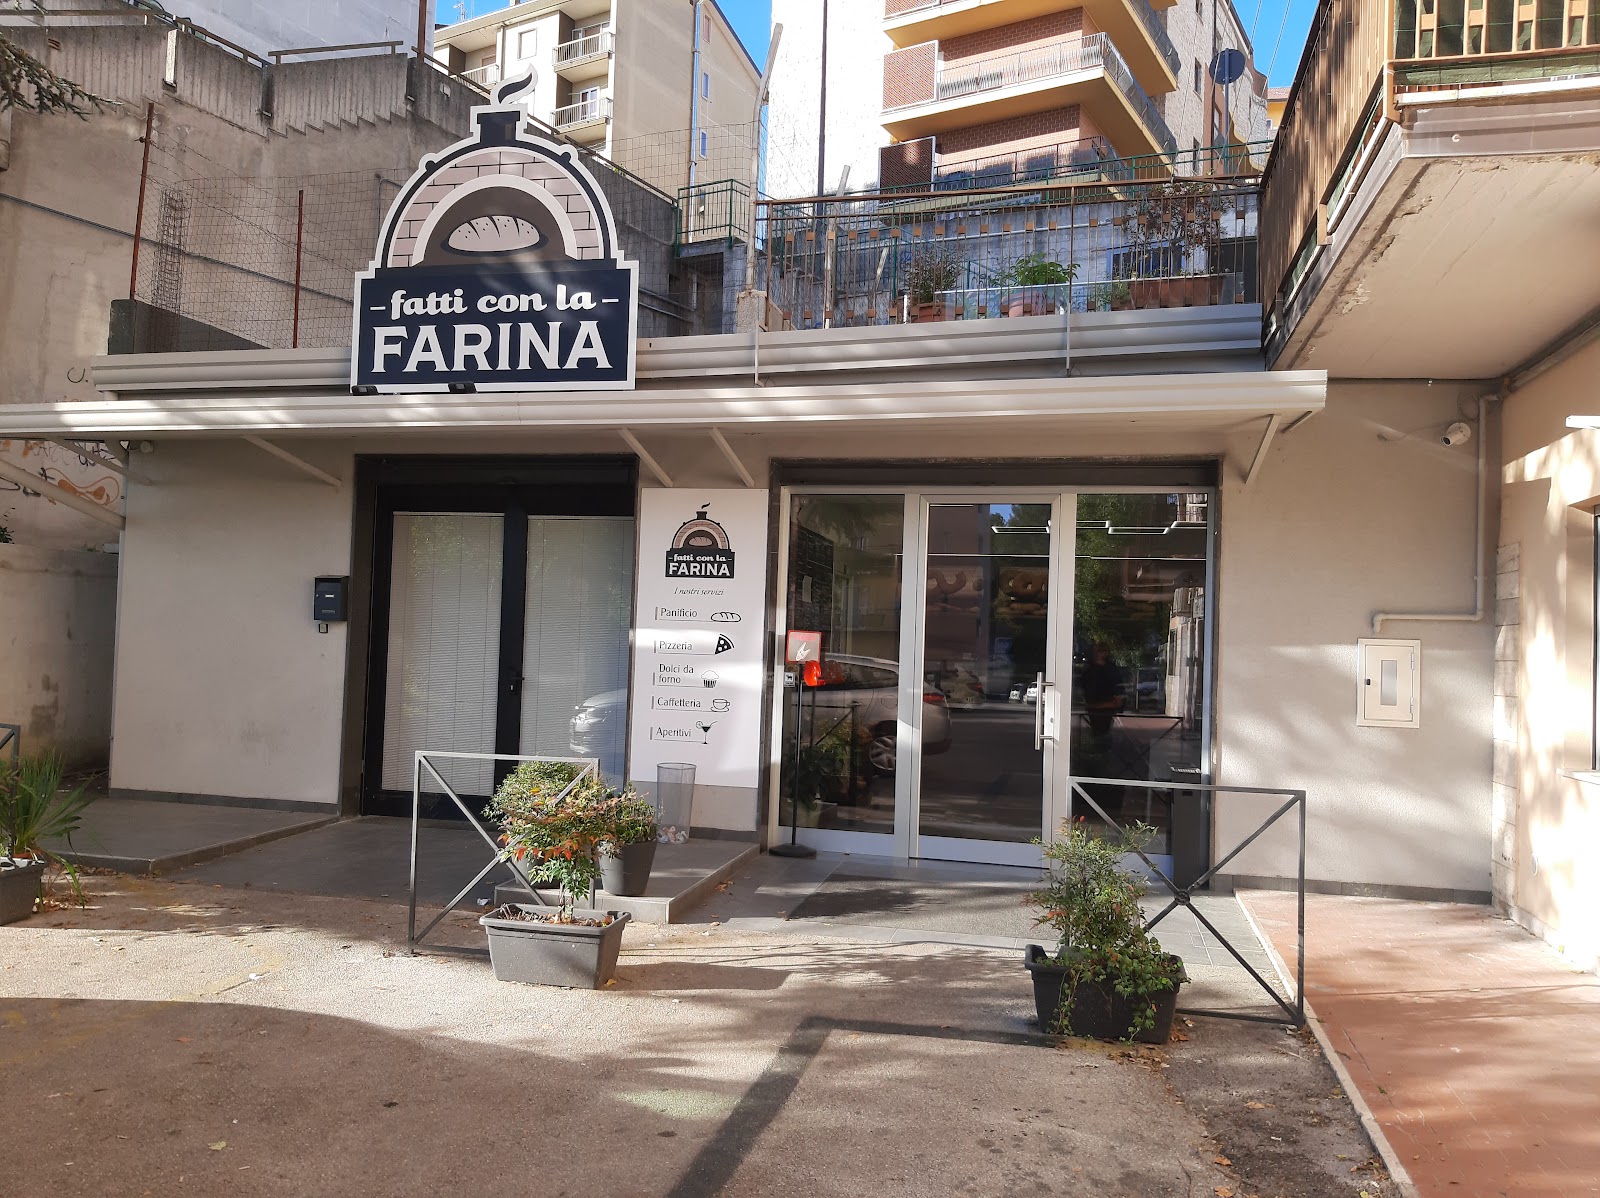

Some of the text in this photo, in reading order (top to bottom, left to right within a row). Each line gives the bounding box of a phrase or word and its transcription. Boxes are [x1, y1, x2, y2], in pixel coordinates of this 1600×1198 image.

[390, 284, 597, 320] fatti con la
[371, 320, 613, 372] FARINA
[669, 563, 730, 576] FARINA
[660, 608, 697, 617] Panificio
[659, 641, 692, 650] Pizzeria
[659, 664, 694, 673] Dolci da
[658, 674, 681, 683] forno
[657, 697, 701, 707] Caffetteria
[656, 727, 691, 738] Aperitivi
